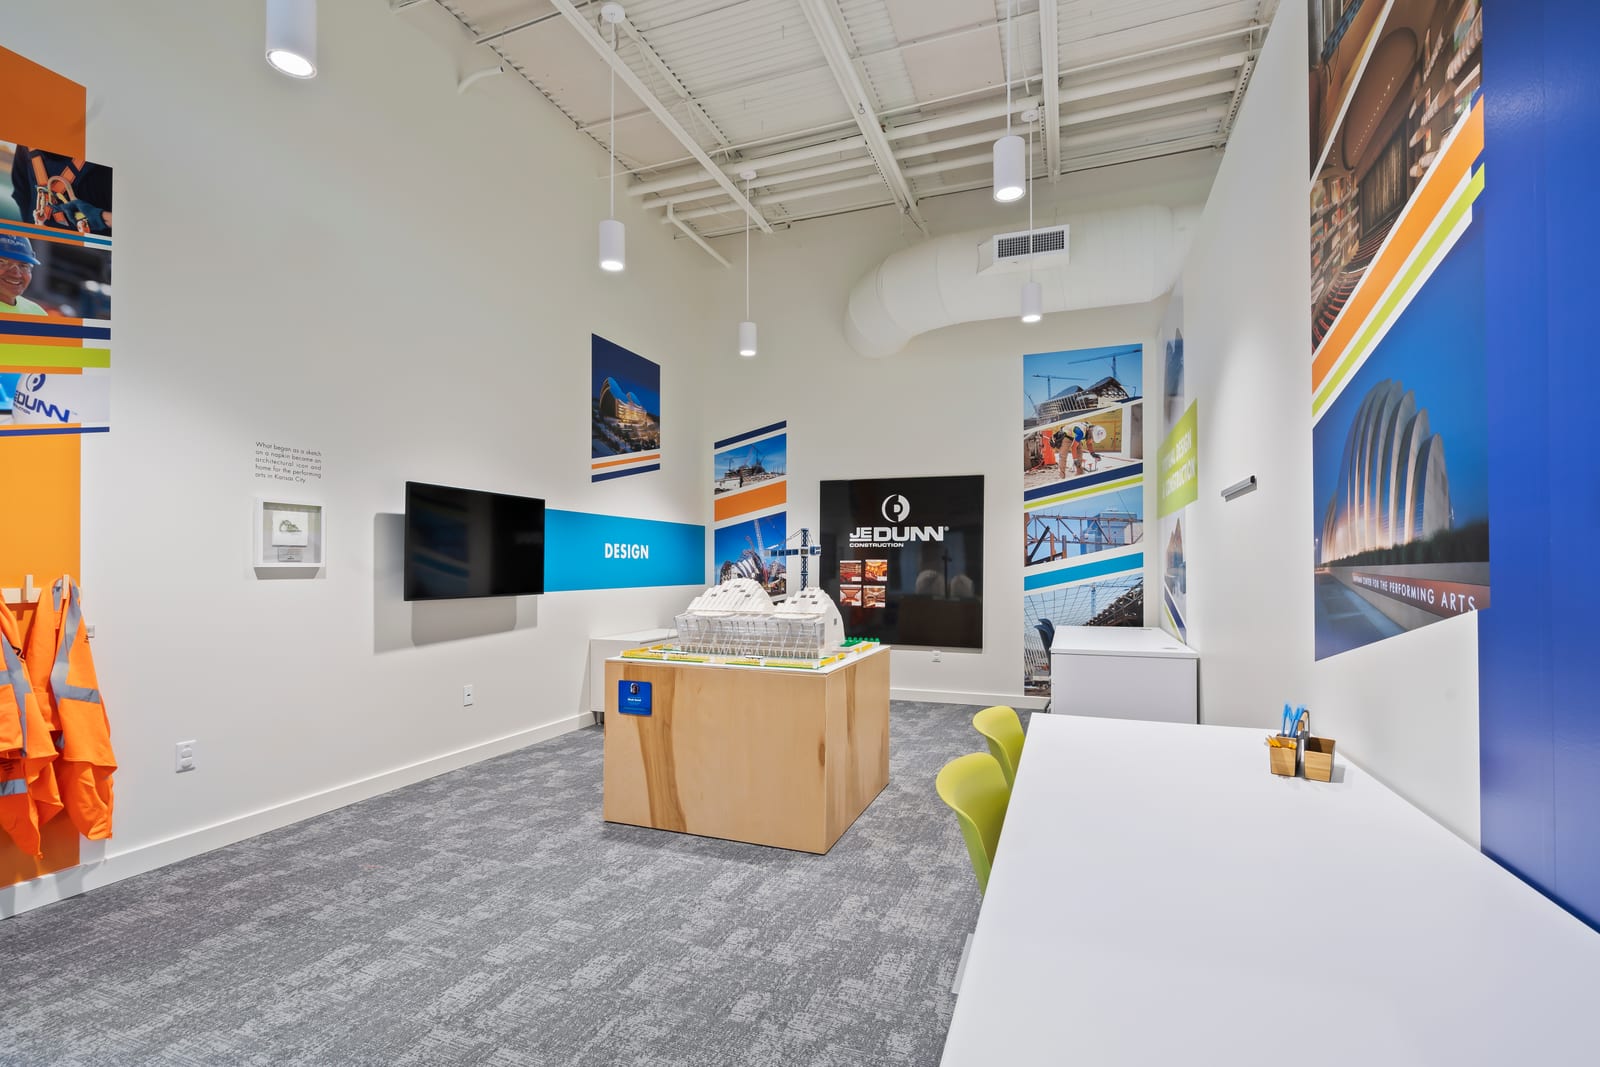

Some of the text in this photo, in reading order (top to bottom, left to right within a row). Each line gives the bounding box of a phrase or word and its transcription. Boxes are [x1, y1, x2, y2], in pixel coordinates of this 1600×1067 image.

[255, 441, 272, 449] What
[273, 444, 291, 453] began
[305, 449, 321, 457] sketch
[255, 457, 294, 467] architectural
[292, 454, 313, 463] became
[292, 469, 321, 479] performing
[295, 476, 306, 484] City
[604, 542, 649, 560] DESIGN
[1372, 578, 1380, 589] FOR
[1379, 580, 1388, 592] THE
[1389, 582, 1435, 605] PERFORMING
[1441, 591, 1476, 613] ARTS
